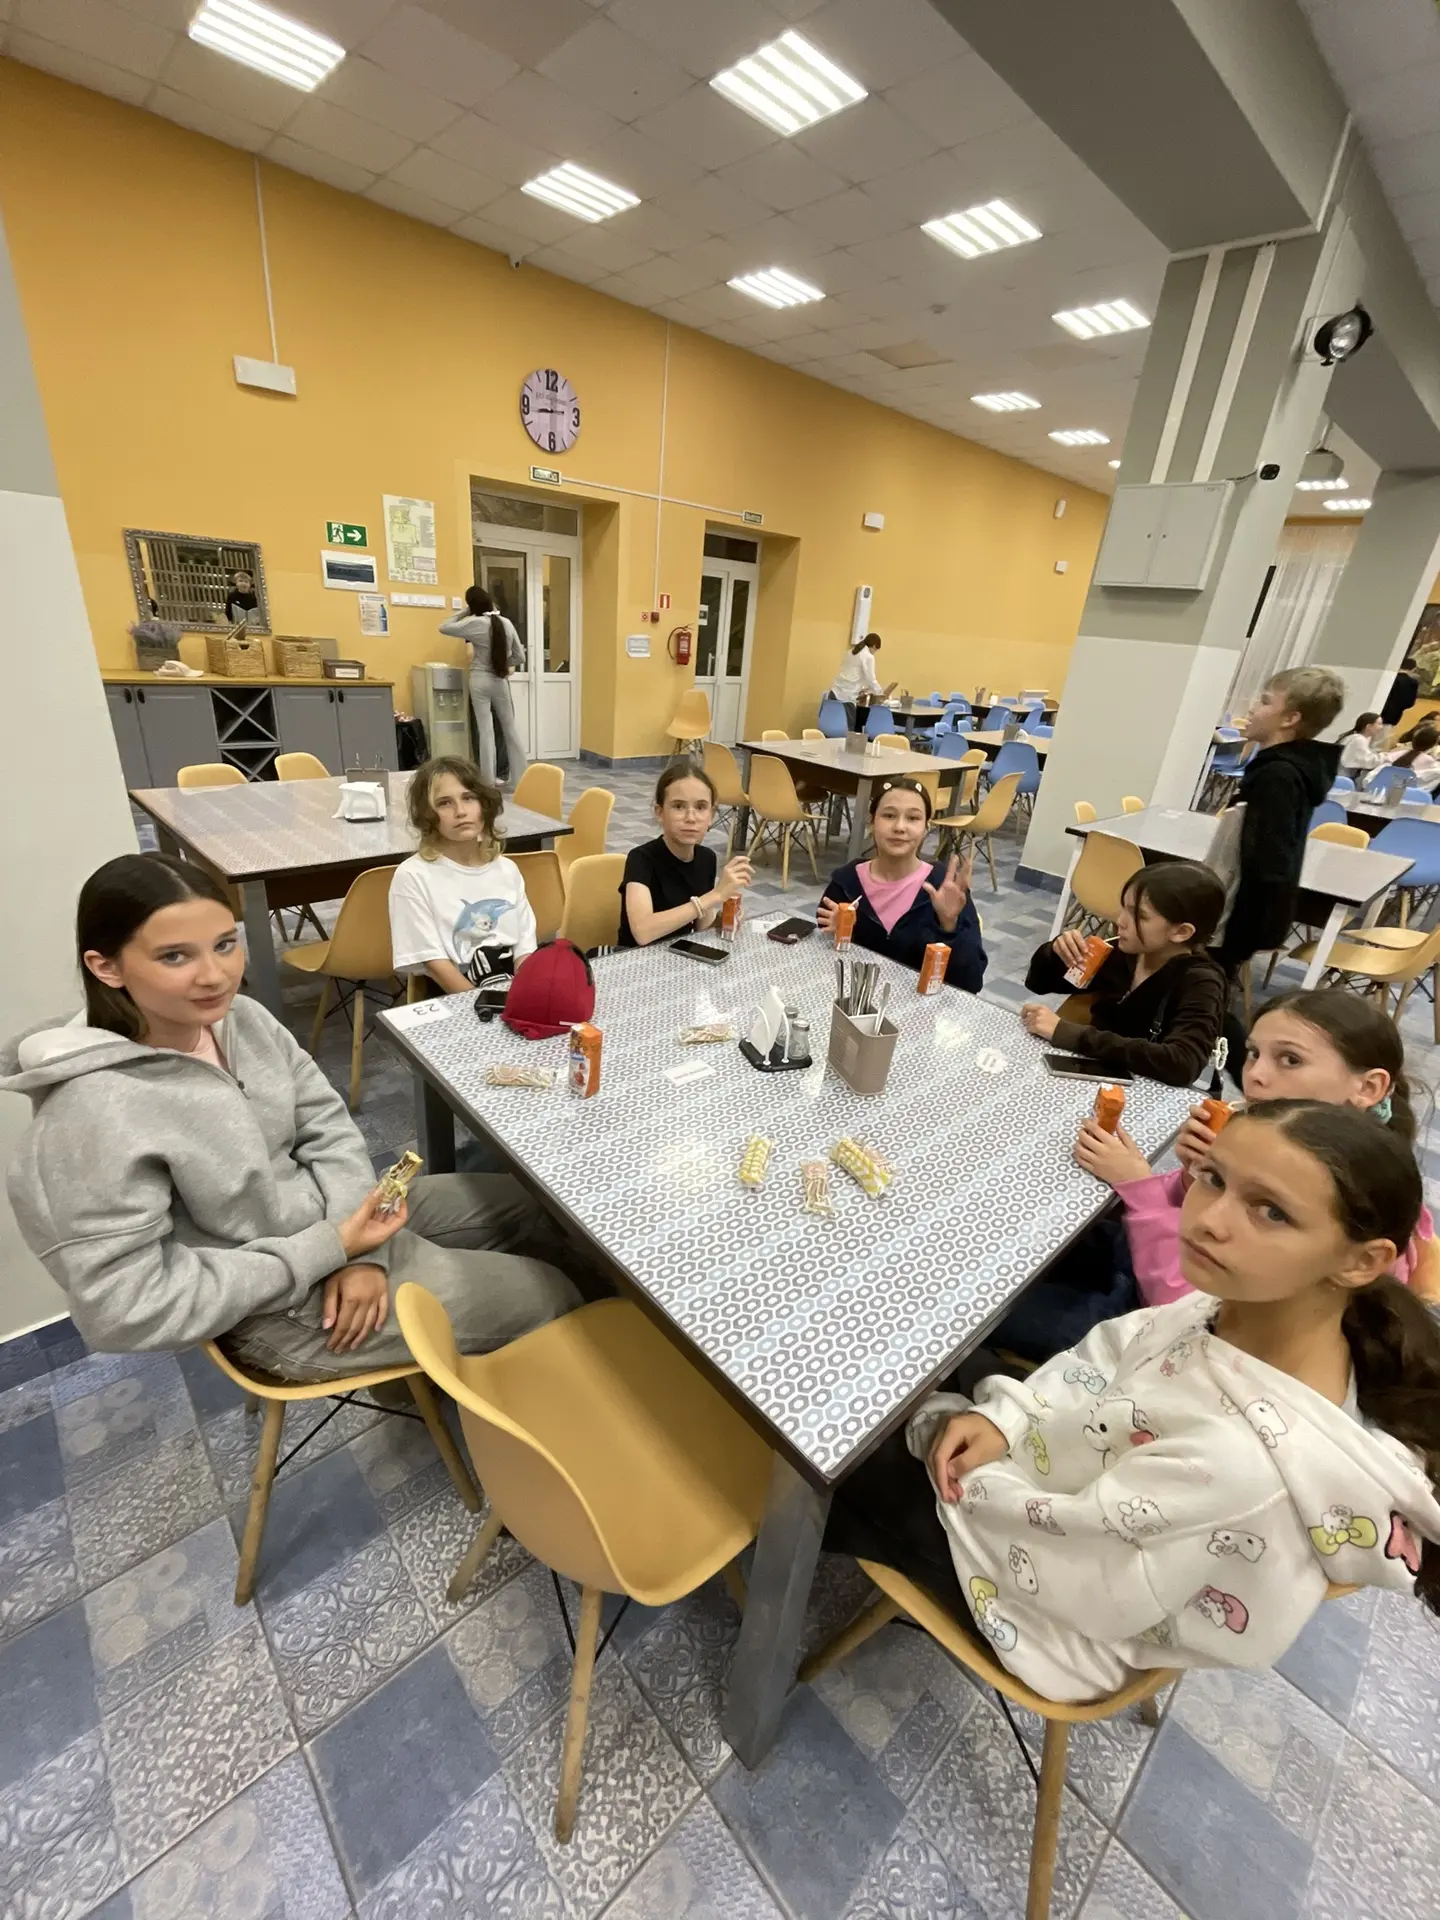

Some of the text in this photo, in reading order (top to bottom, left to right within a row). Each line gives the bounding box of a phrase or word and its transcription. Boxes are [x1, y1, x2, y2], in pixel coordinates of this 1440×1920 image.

[545, 369, 559, 393] 12
[522, 394, 530, 415] 9
[572, 407, 580, 428] 3
[548, 431, 556, 452] 6
[412, 1003, 440, 1016] 23
